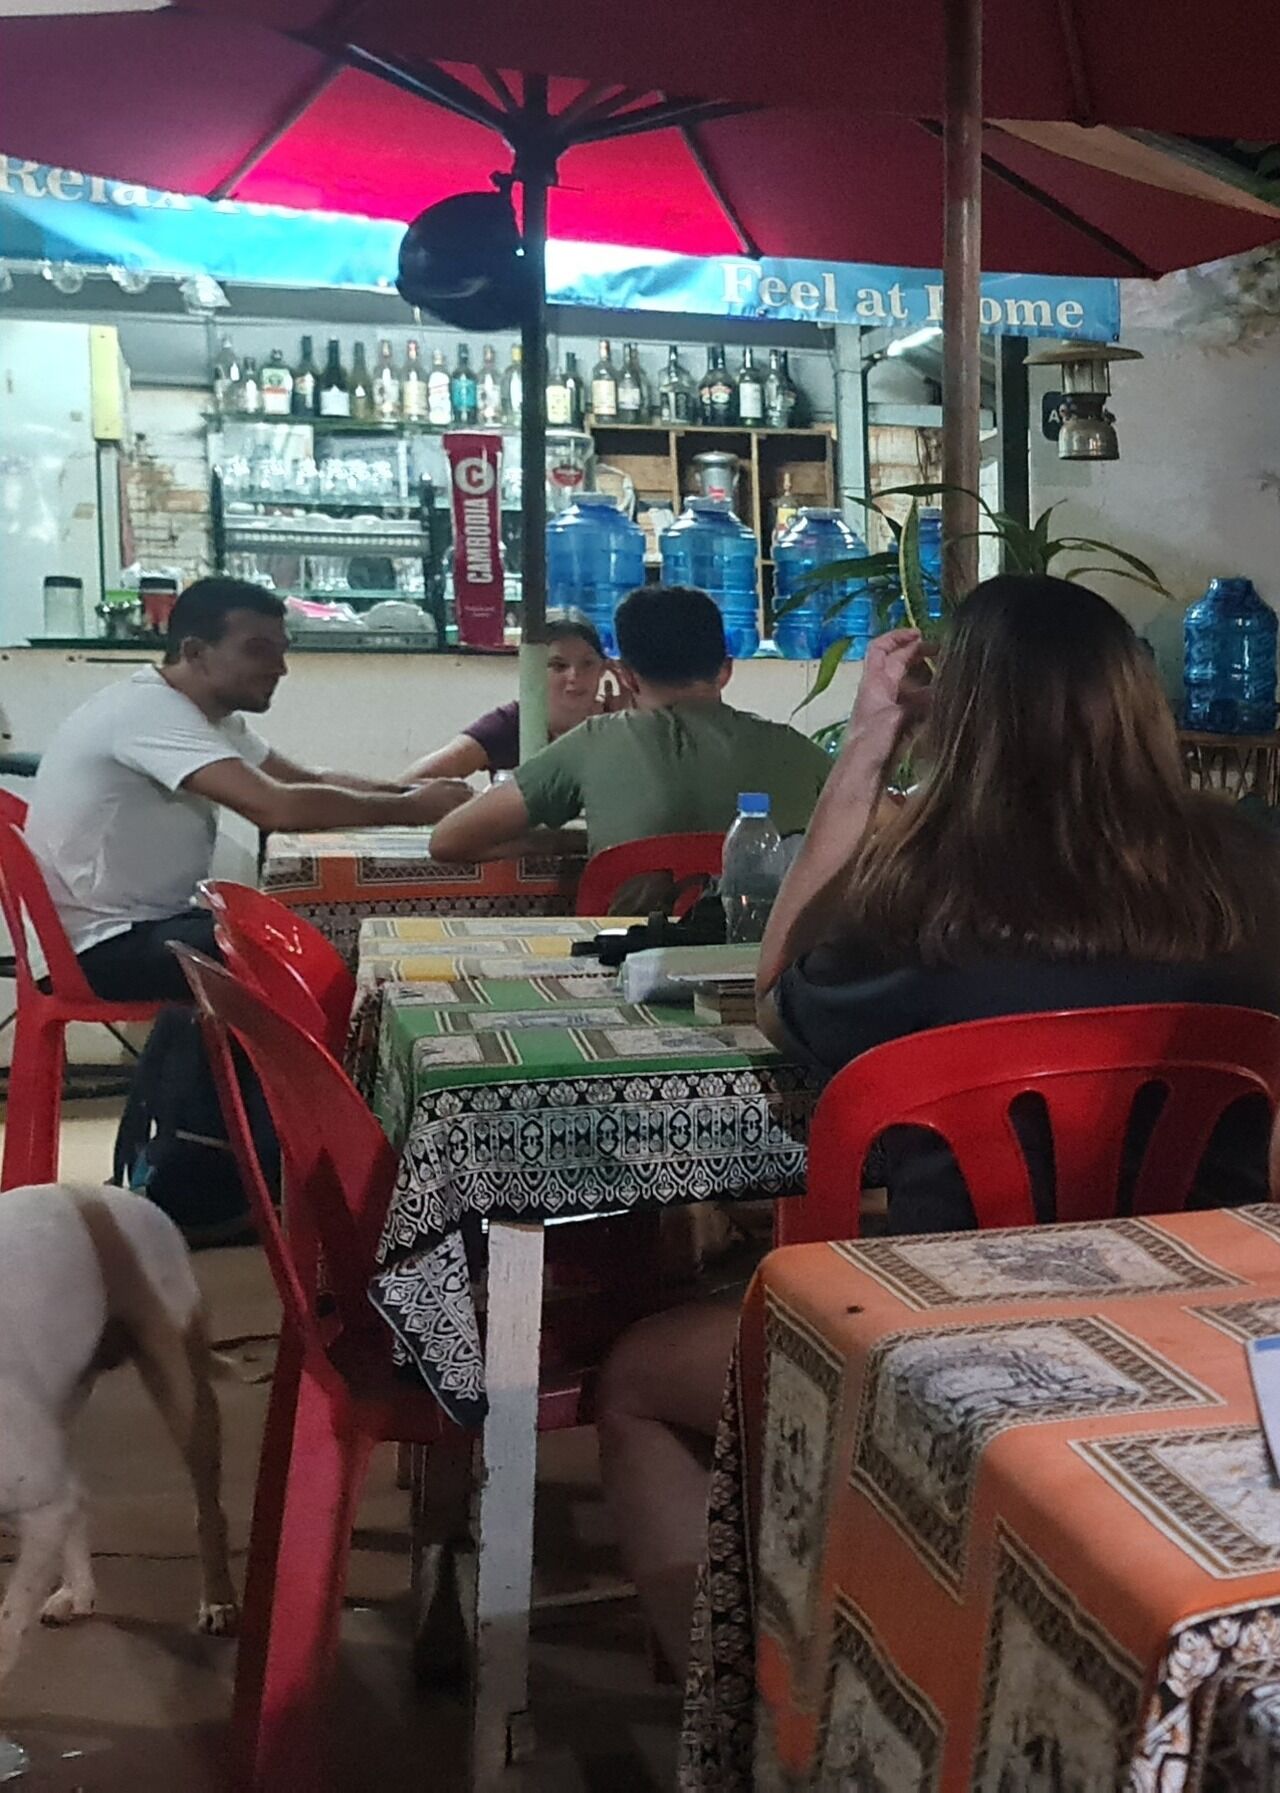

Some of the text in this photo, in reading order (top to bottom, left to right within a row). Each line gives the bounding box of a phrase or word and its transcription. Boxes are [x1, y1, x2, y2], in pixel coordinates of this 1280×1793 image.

[719, 261, 838, 314] Feel
[855, 284, 908, 320] at
[463, 498, 494, 584] CAMBODIA
